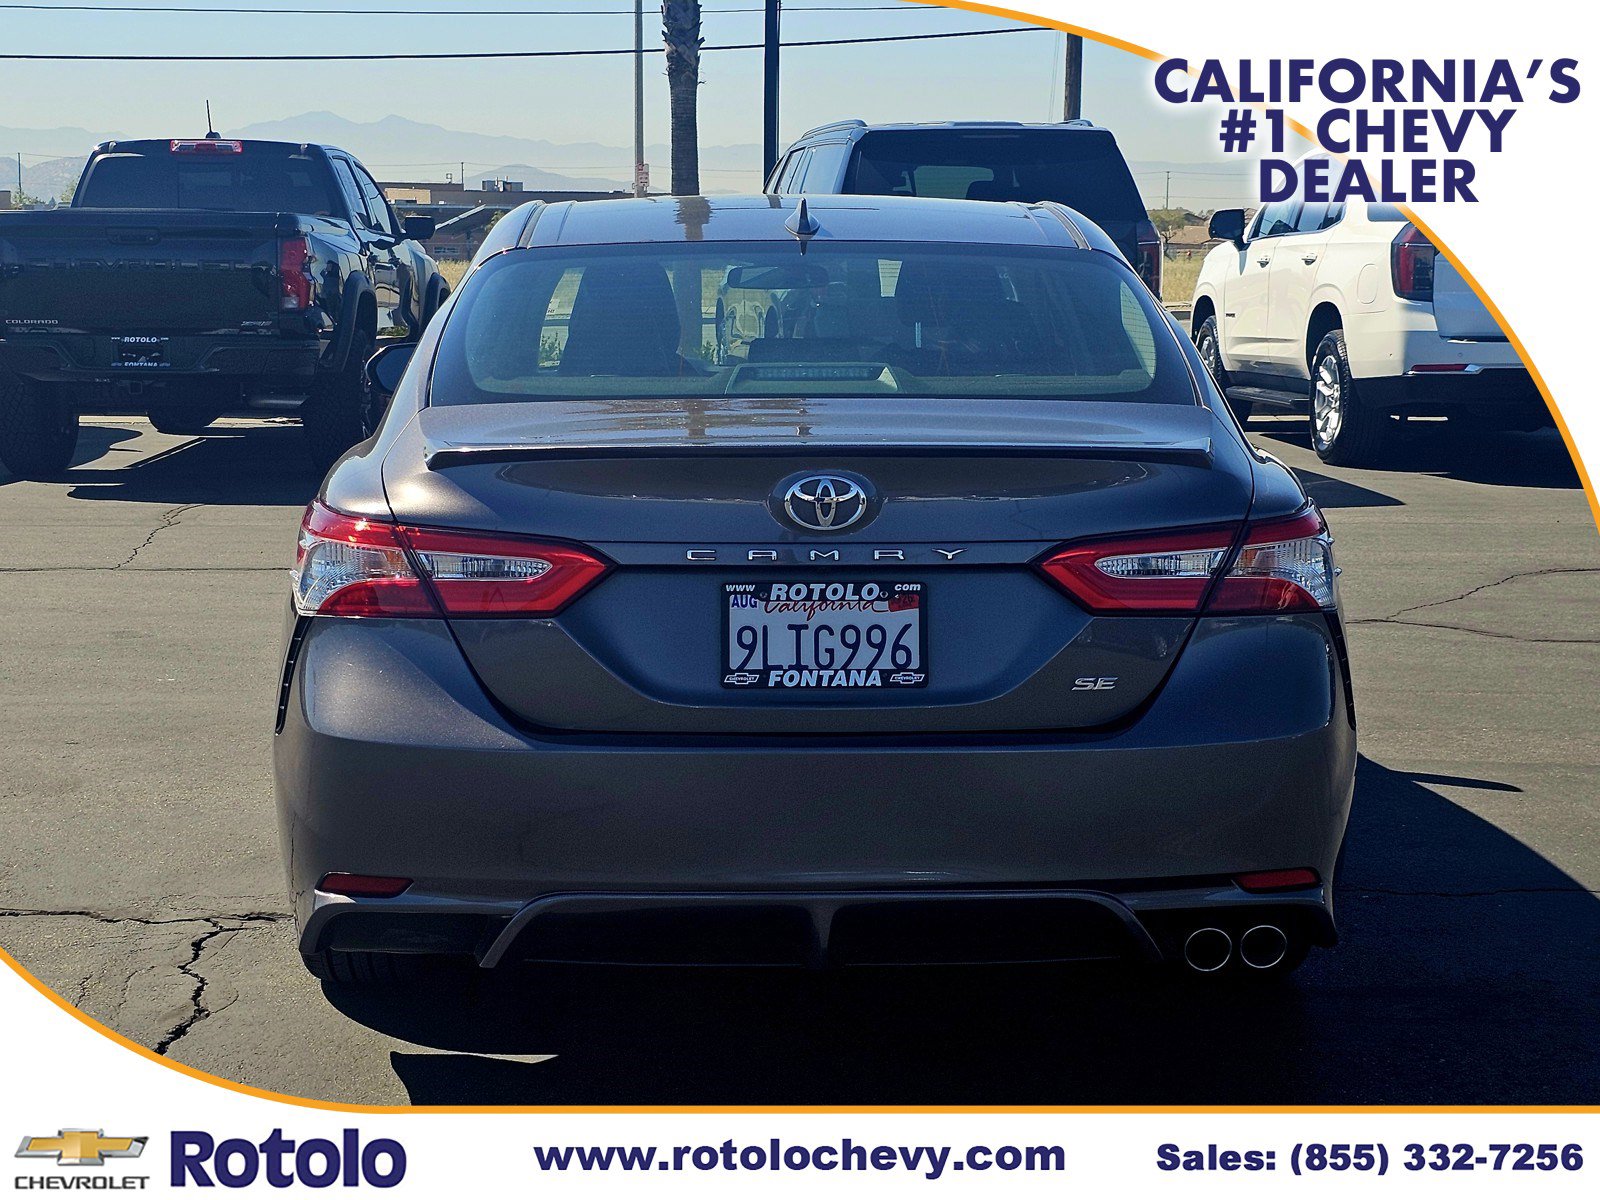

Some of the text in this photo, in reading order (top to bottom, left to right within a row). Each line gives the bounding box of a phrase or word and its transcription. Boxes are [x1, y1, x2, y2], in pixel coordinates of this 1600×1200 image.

[686, 549, 967, 561] CAMRY
[725, 583, 921, 601] www ROTOLO com
[731, 595, 758, 608] AUG
[732, 623, 913, 670] 9LIG996
[768, 670, 882, 687] FONTANA
[1071, 677, 1118, 691] SE
